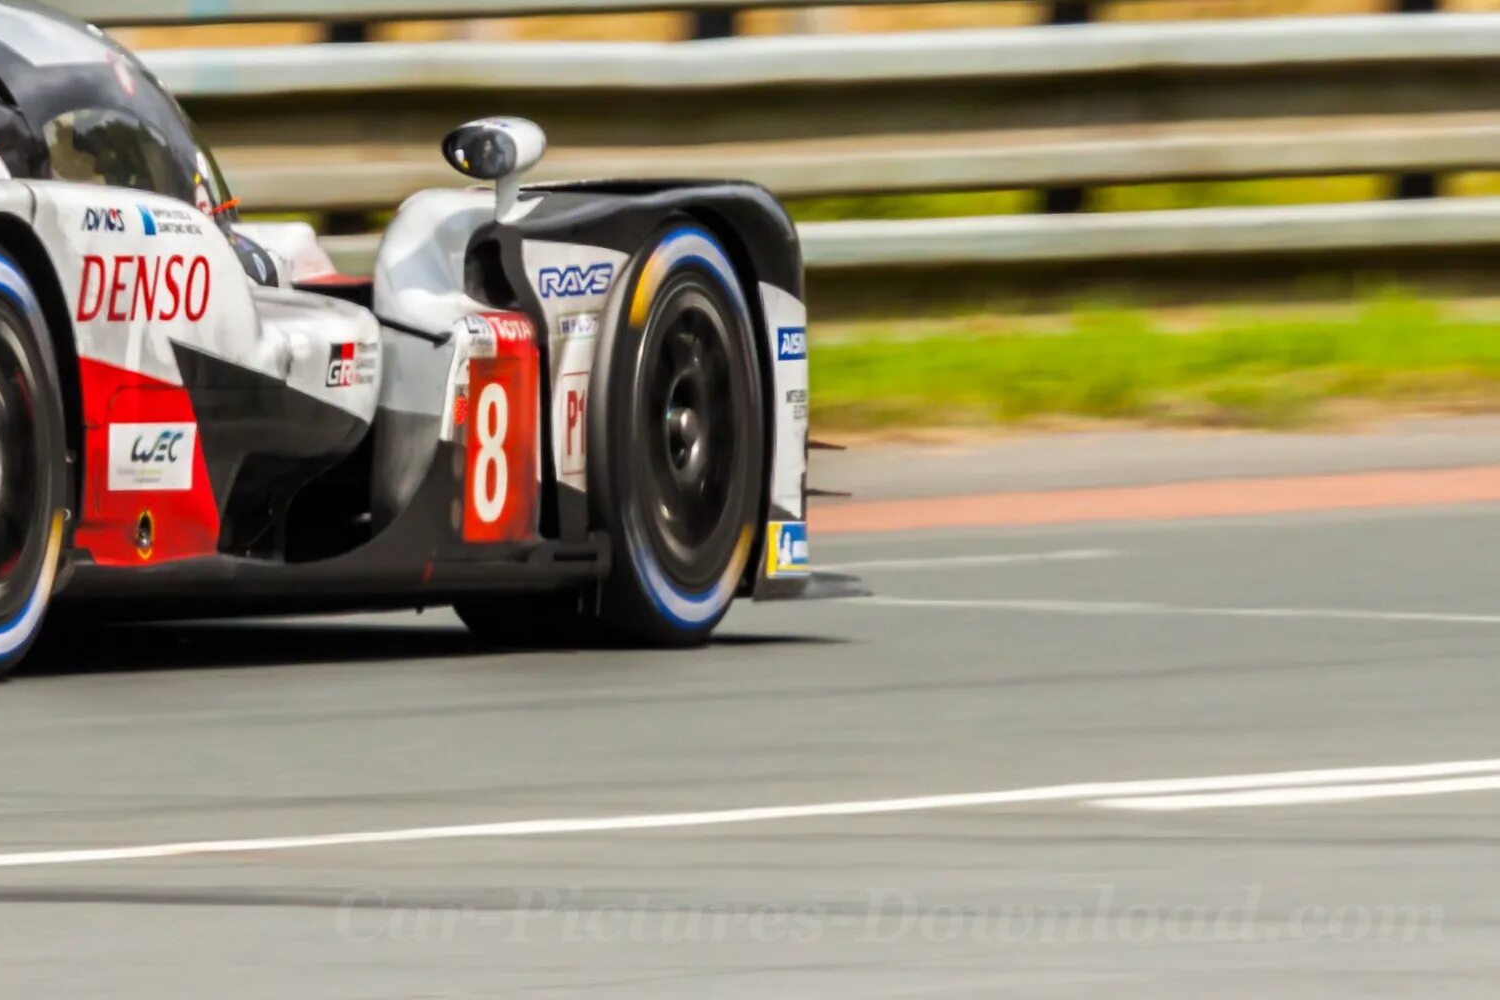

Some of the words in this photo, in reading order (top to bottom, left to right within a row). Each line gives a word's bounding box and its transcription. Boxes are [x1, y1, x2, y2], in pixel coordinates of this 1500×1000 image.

[76, 254, 211, 322] DENSO
[539, 263, 614, 298] RAYS
[131, 430, 184, 463] WEC
[474, 382, 508, 523] 8
[567, 389, 586, 456] P1
